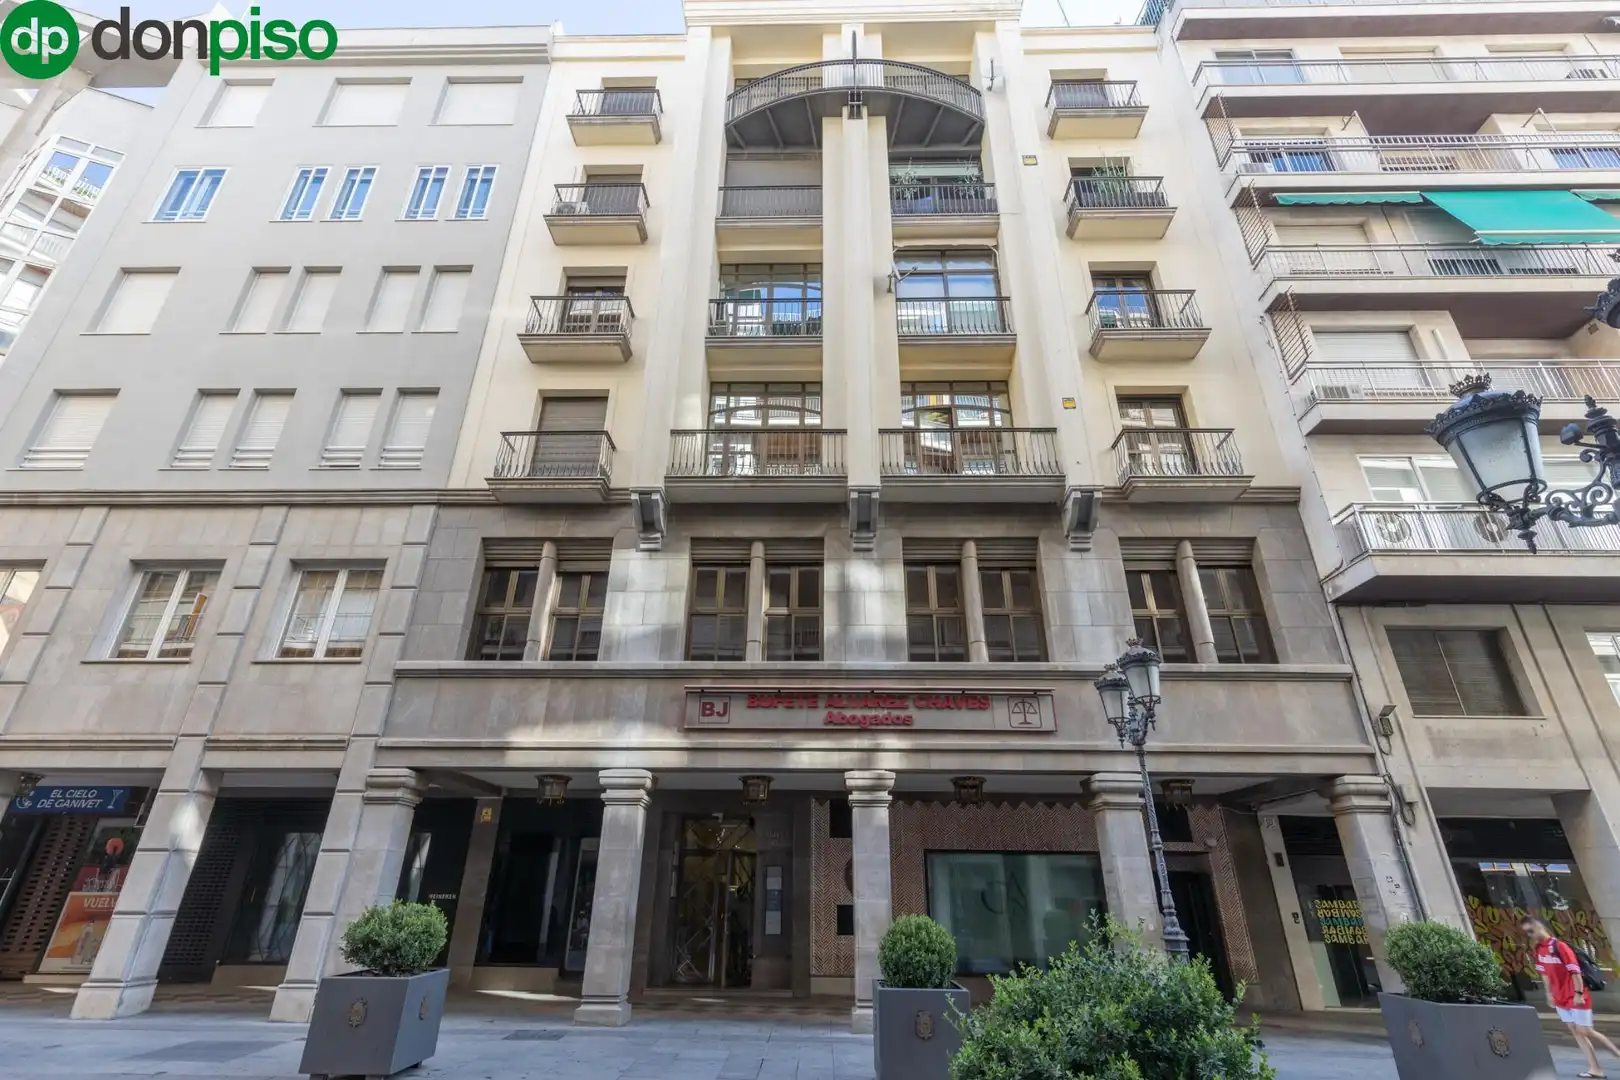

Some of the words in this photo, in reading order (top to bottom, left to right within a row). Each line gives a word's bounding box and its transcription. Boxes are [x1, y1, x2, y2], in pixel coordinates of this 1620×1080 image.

[701, 701, 729, 717] BJ
[746, 693, 818, 709] BUFETE
[914, 694, 990, 710] CHAVES
[823, 711, 914, 728] Abogados
[50, 789, 62, 798] EL
[65, 789, 98, 798] CIELO
[36, 799, 52, 808] DE
[54, 799, 103, 809] GANIVET
